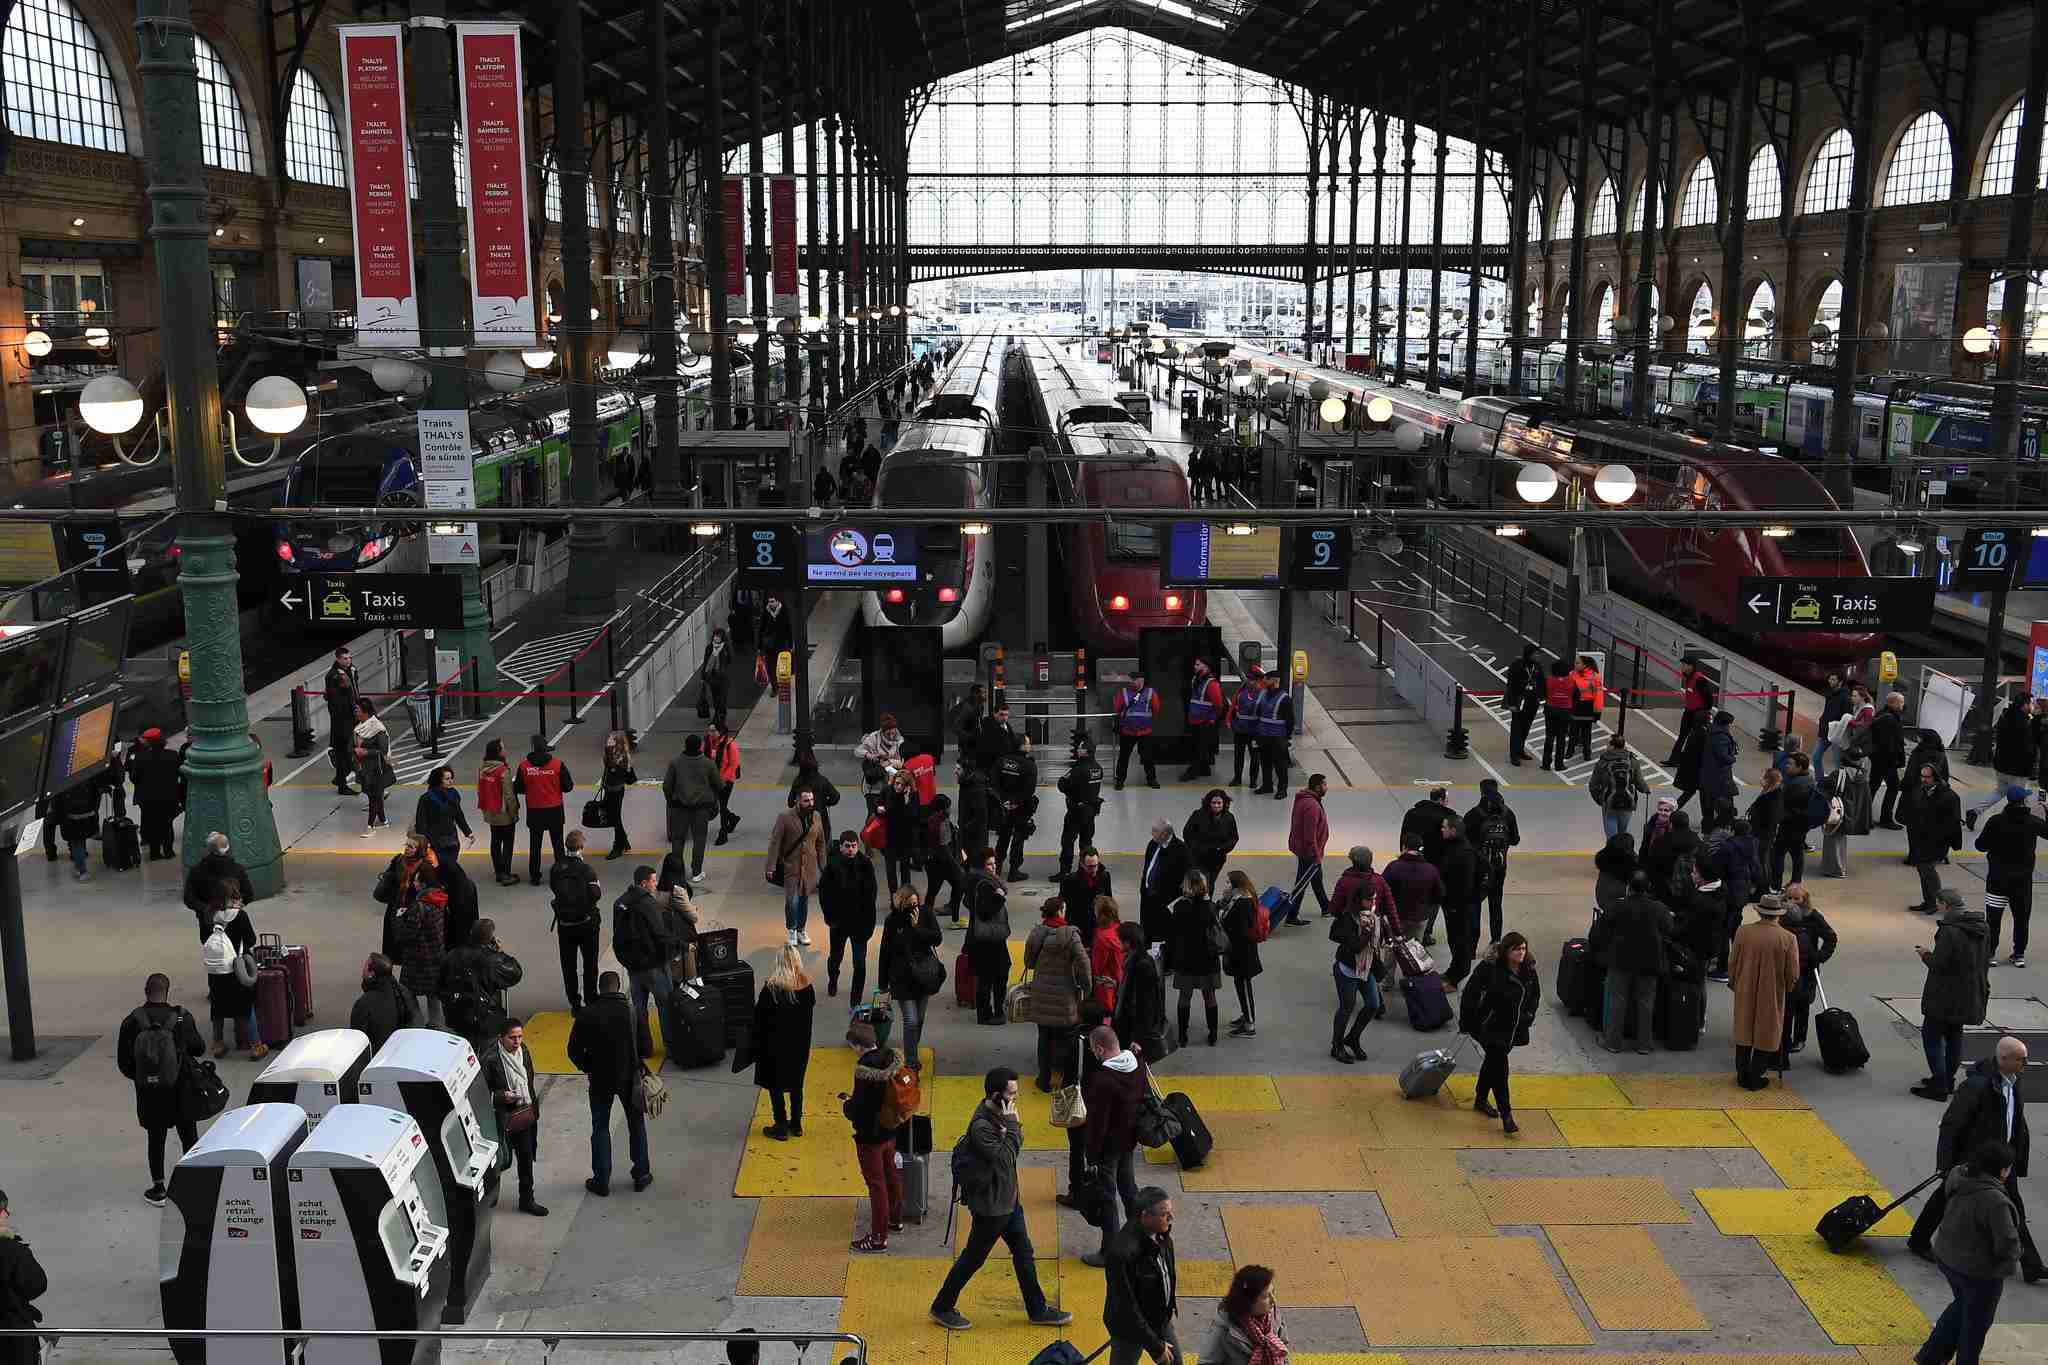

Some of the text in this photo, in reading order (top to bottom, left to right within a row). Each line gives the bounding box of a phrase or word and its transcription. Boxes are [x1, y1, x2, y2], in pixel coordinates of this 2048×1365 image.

[424, 419, 454, 428] Trains
[424, 432, 464, 440] THALYS
[424, 443, 463, 451] Contrôle
[88, 544, 105, 567] 7
[756, 543, 773, 566] 8
[1314, 542, 1330, 565] 9
[1973, 543, 2007, 567] 10
[812, 568, 912, 578] Ne prend pas de voyageurs
[327, 580, 345, 588] Taxis
[1799, 584, 1817, 592] Taxis
[361, 591, 406, 607] Taxis
[1832, 595, 1877, 611] Taxis
[363, 612, 385, 621] Taxis
[1831, 616, 1854, 625] Taxis
[226, 1207, 256, 1215] retrait
[299, 1208, 329, 1216] retrait
[226, 1215, 264, 1225] échange
[300, 1216, 337, 1226] échange
